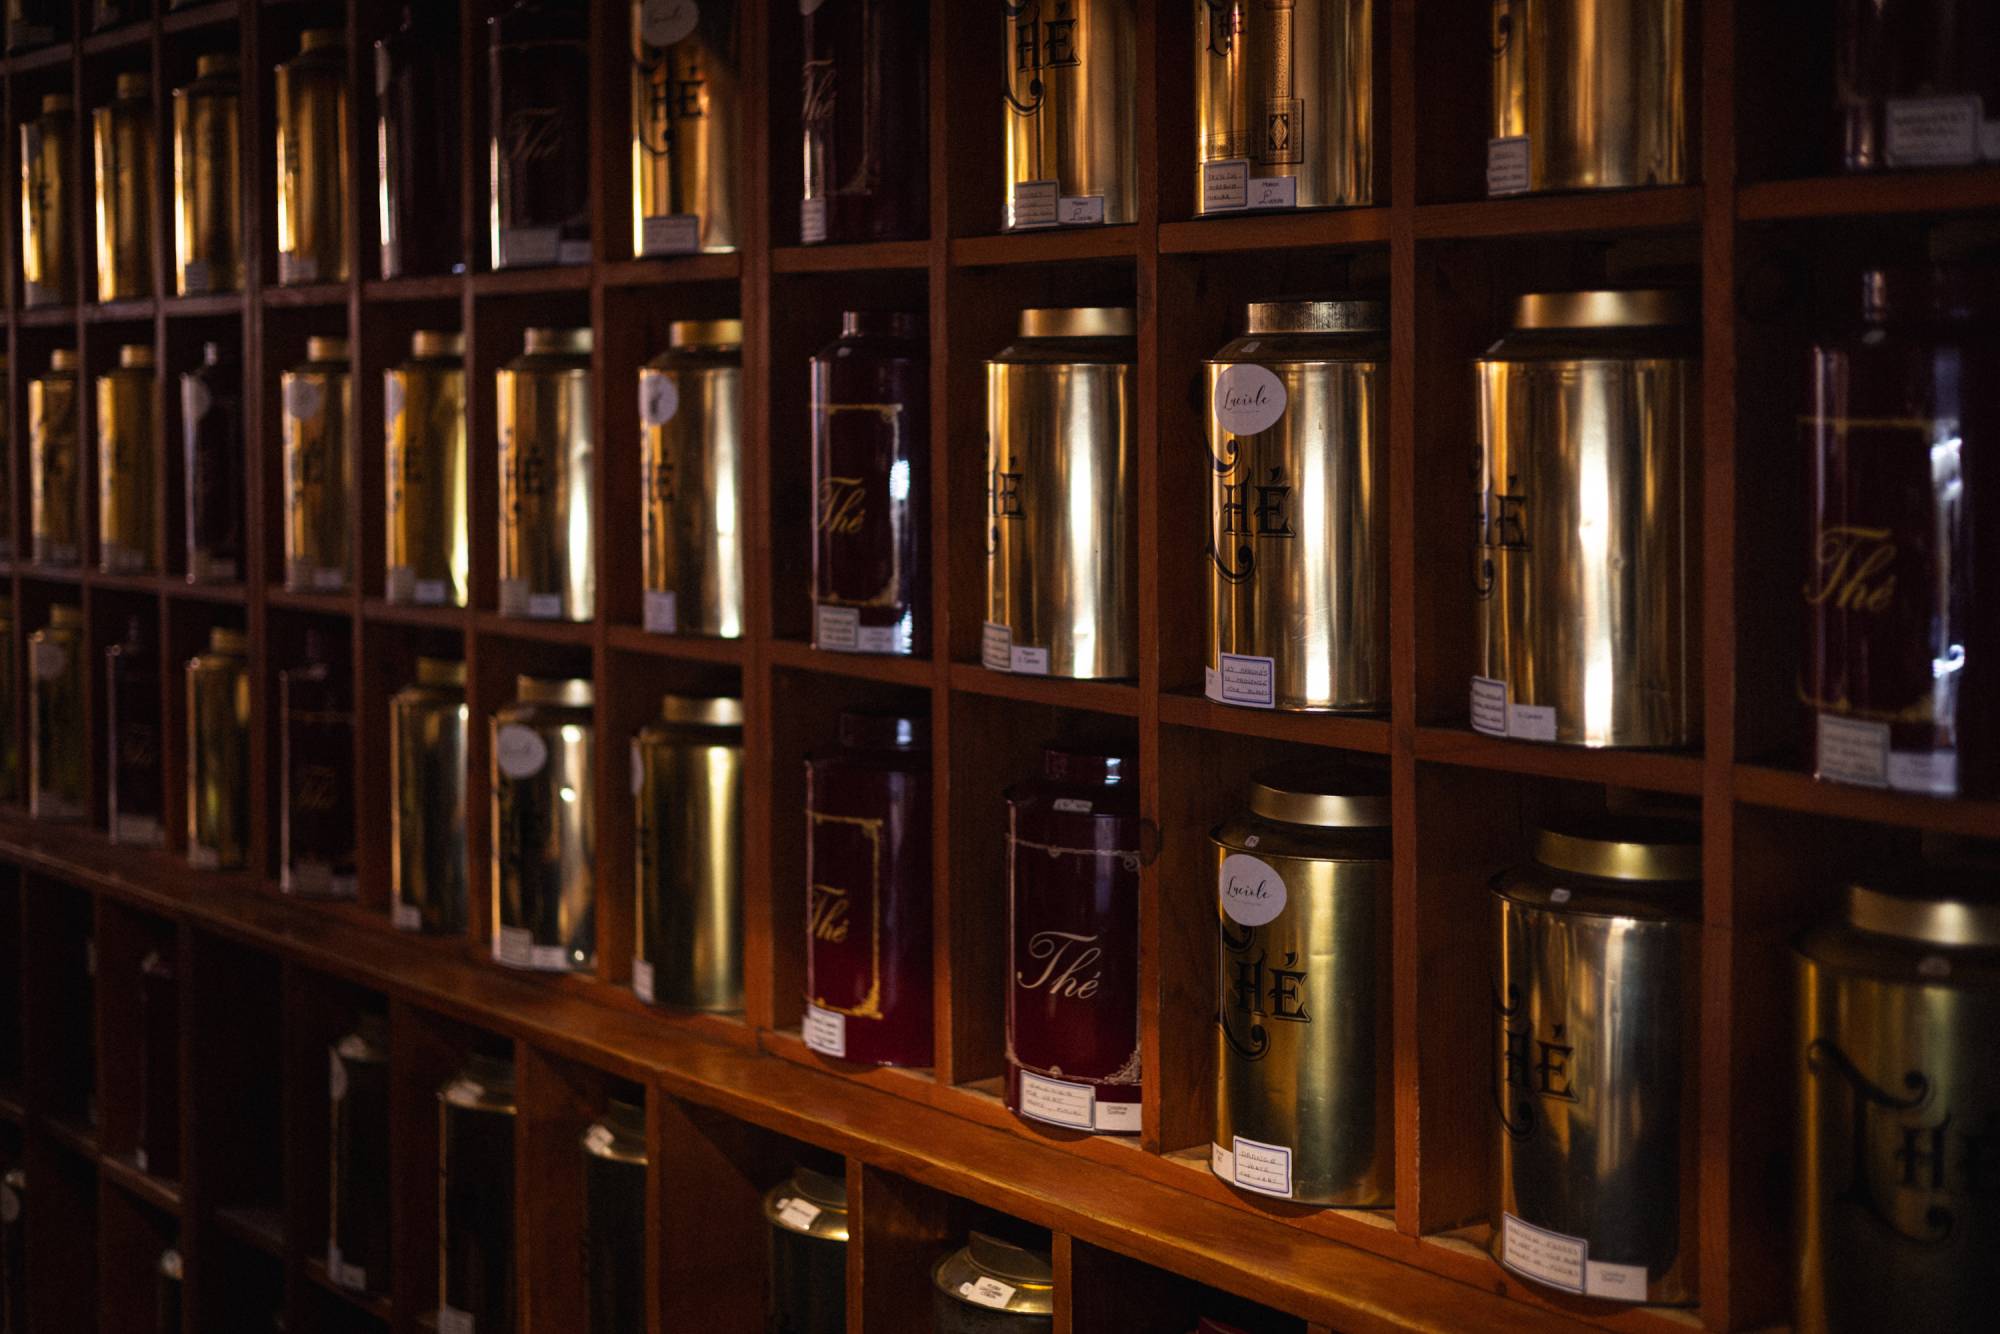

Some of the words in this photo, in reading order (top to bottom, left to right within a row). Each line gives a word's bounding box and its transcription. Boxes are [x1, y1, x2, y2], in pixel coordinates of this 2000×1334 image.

[818, 474, 866, 536] Thé
[1802, 526, 1898, 615] Thé
[1226, 874, 1272, 900] Luciole
[1016, 930, 1102, 1000] Thé
